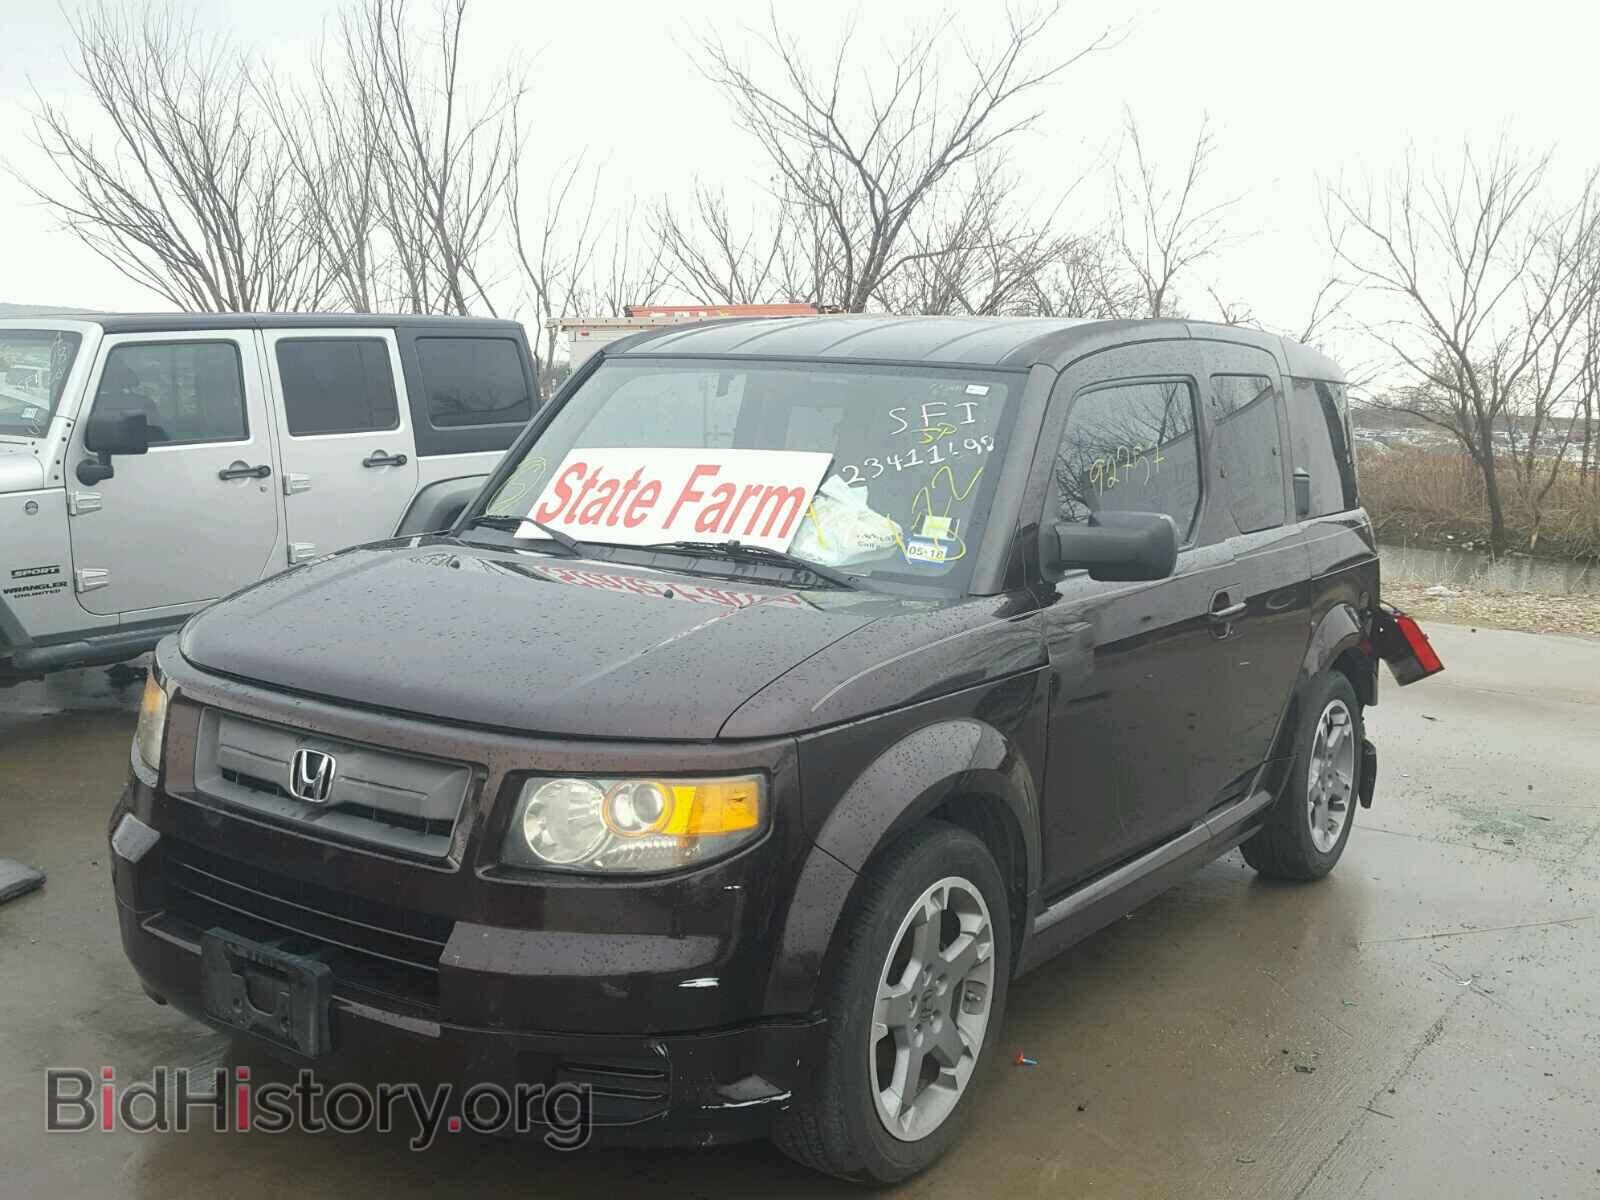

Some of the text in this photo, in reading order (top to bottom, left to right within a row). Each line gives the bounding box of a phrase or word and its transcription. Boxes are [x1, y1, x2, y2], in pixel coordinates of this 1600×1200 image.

[536, 462, 662, 529] State
[661, 464, 806, 539] Farm
[13, 567, 60, 578] SPORT
[3, 581, 68, 594] WRANGLER
